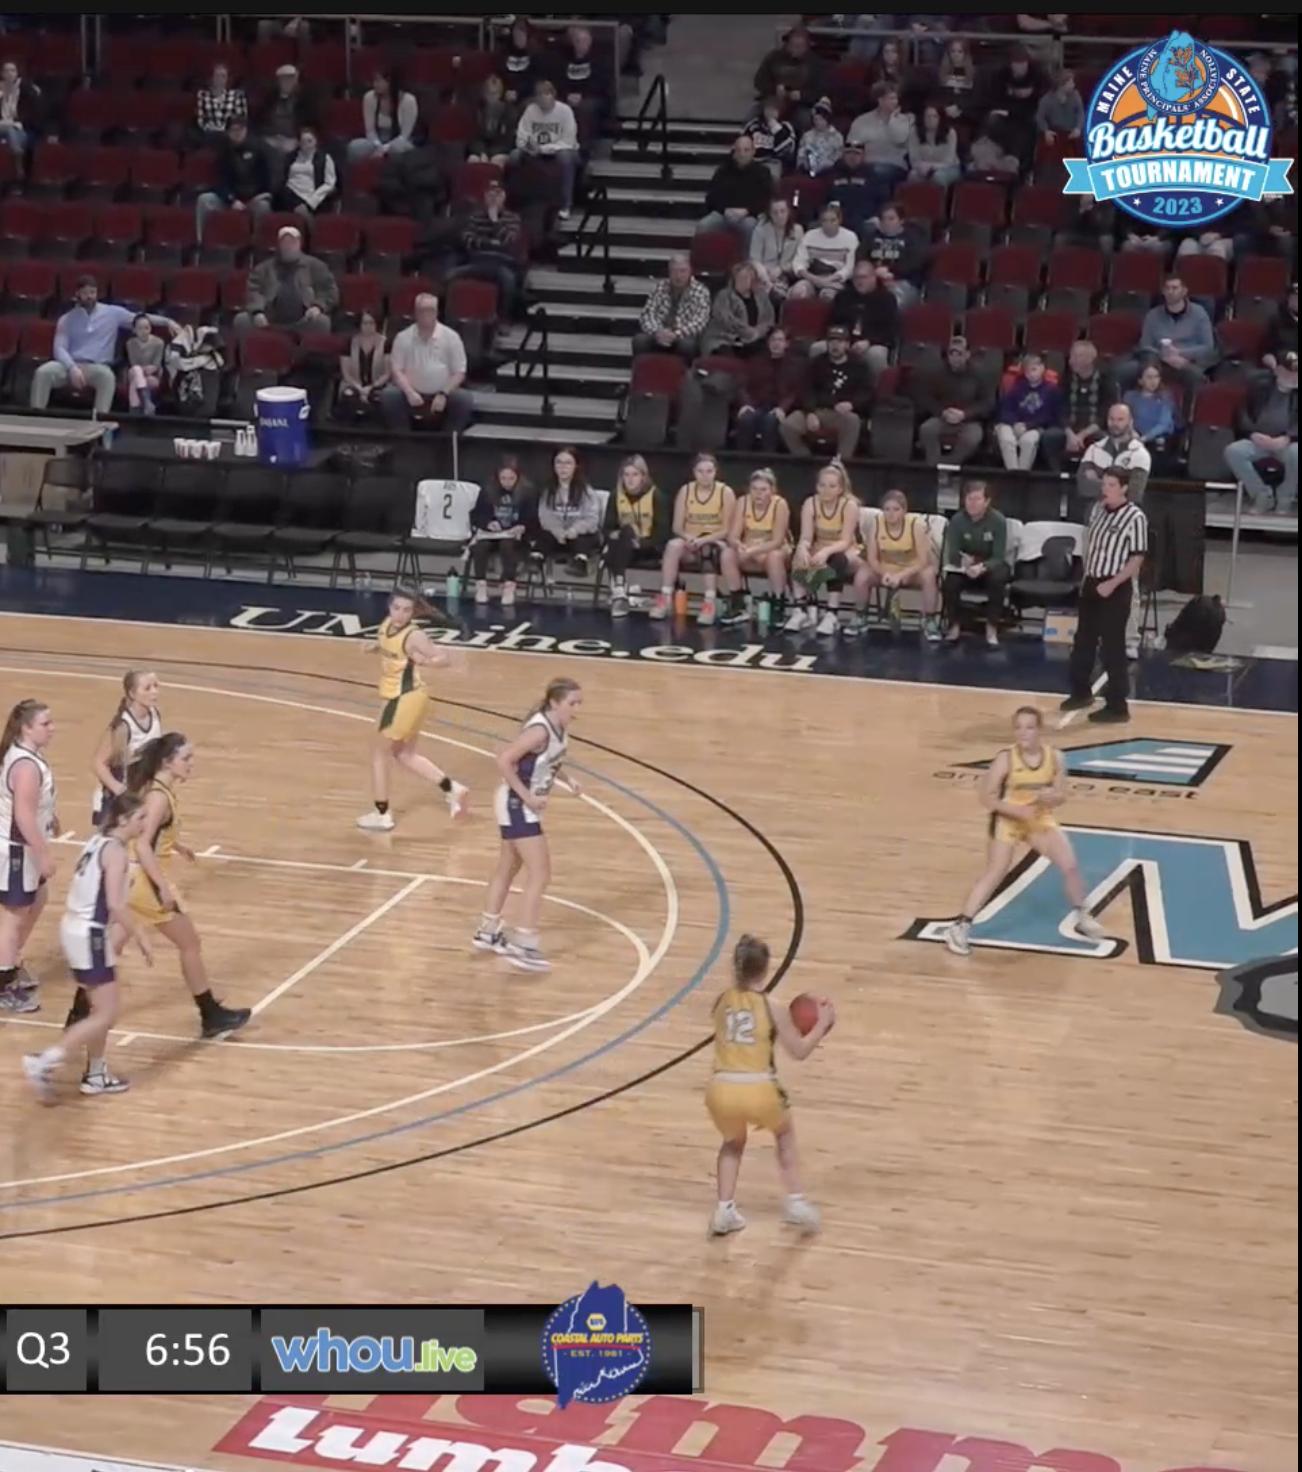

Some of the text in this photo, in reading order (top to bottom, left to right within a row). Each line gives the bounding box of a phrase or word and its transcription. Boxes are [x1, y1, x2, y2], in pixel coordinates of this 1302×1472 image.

[442, 493, 454, 520] 2
[1107, 785, 1200, 800] east
[725, 1006, 757, 1044] 12
